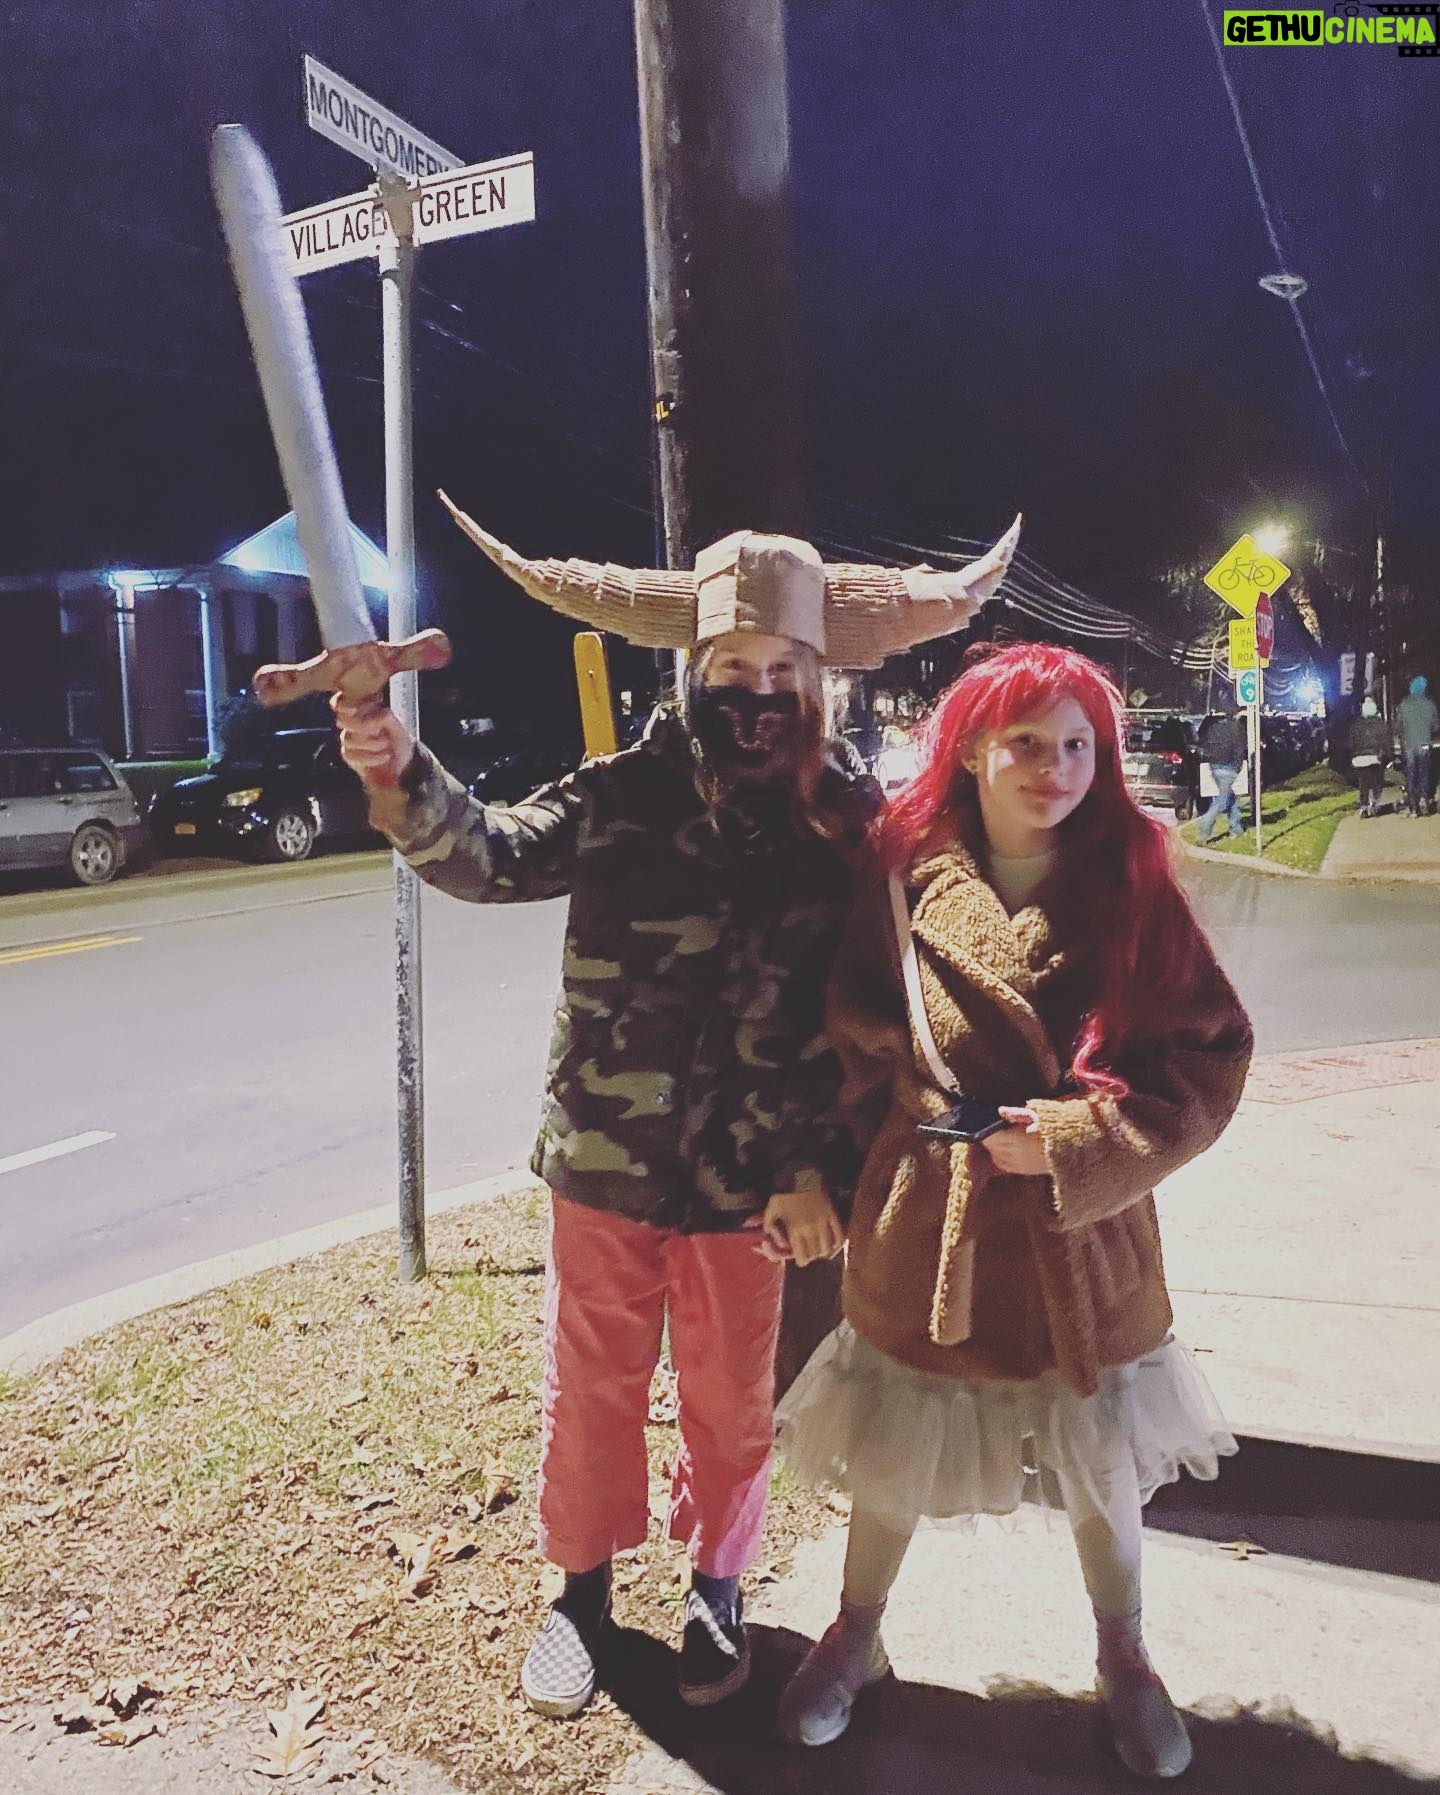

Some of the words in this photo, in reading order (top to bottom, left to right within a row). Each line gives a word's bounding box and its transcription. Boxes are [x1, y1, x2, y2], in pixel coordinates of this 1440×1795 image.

[291, 203, 385, 260] VILLAGE
[419, 177, 506, 227] GREEN
[1234, 626, 1254, 637] SHA
[1257, 611, 1273, 640] STOP
[1238, 653, 1254, 663] ROA
